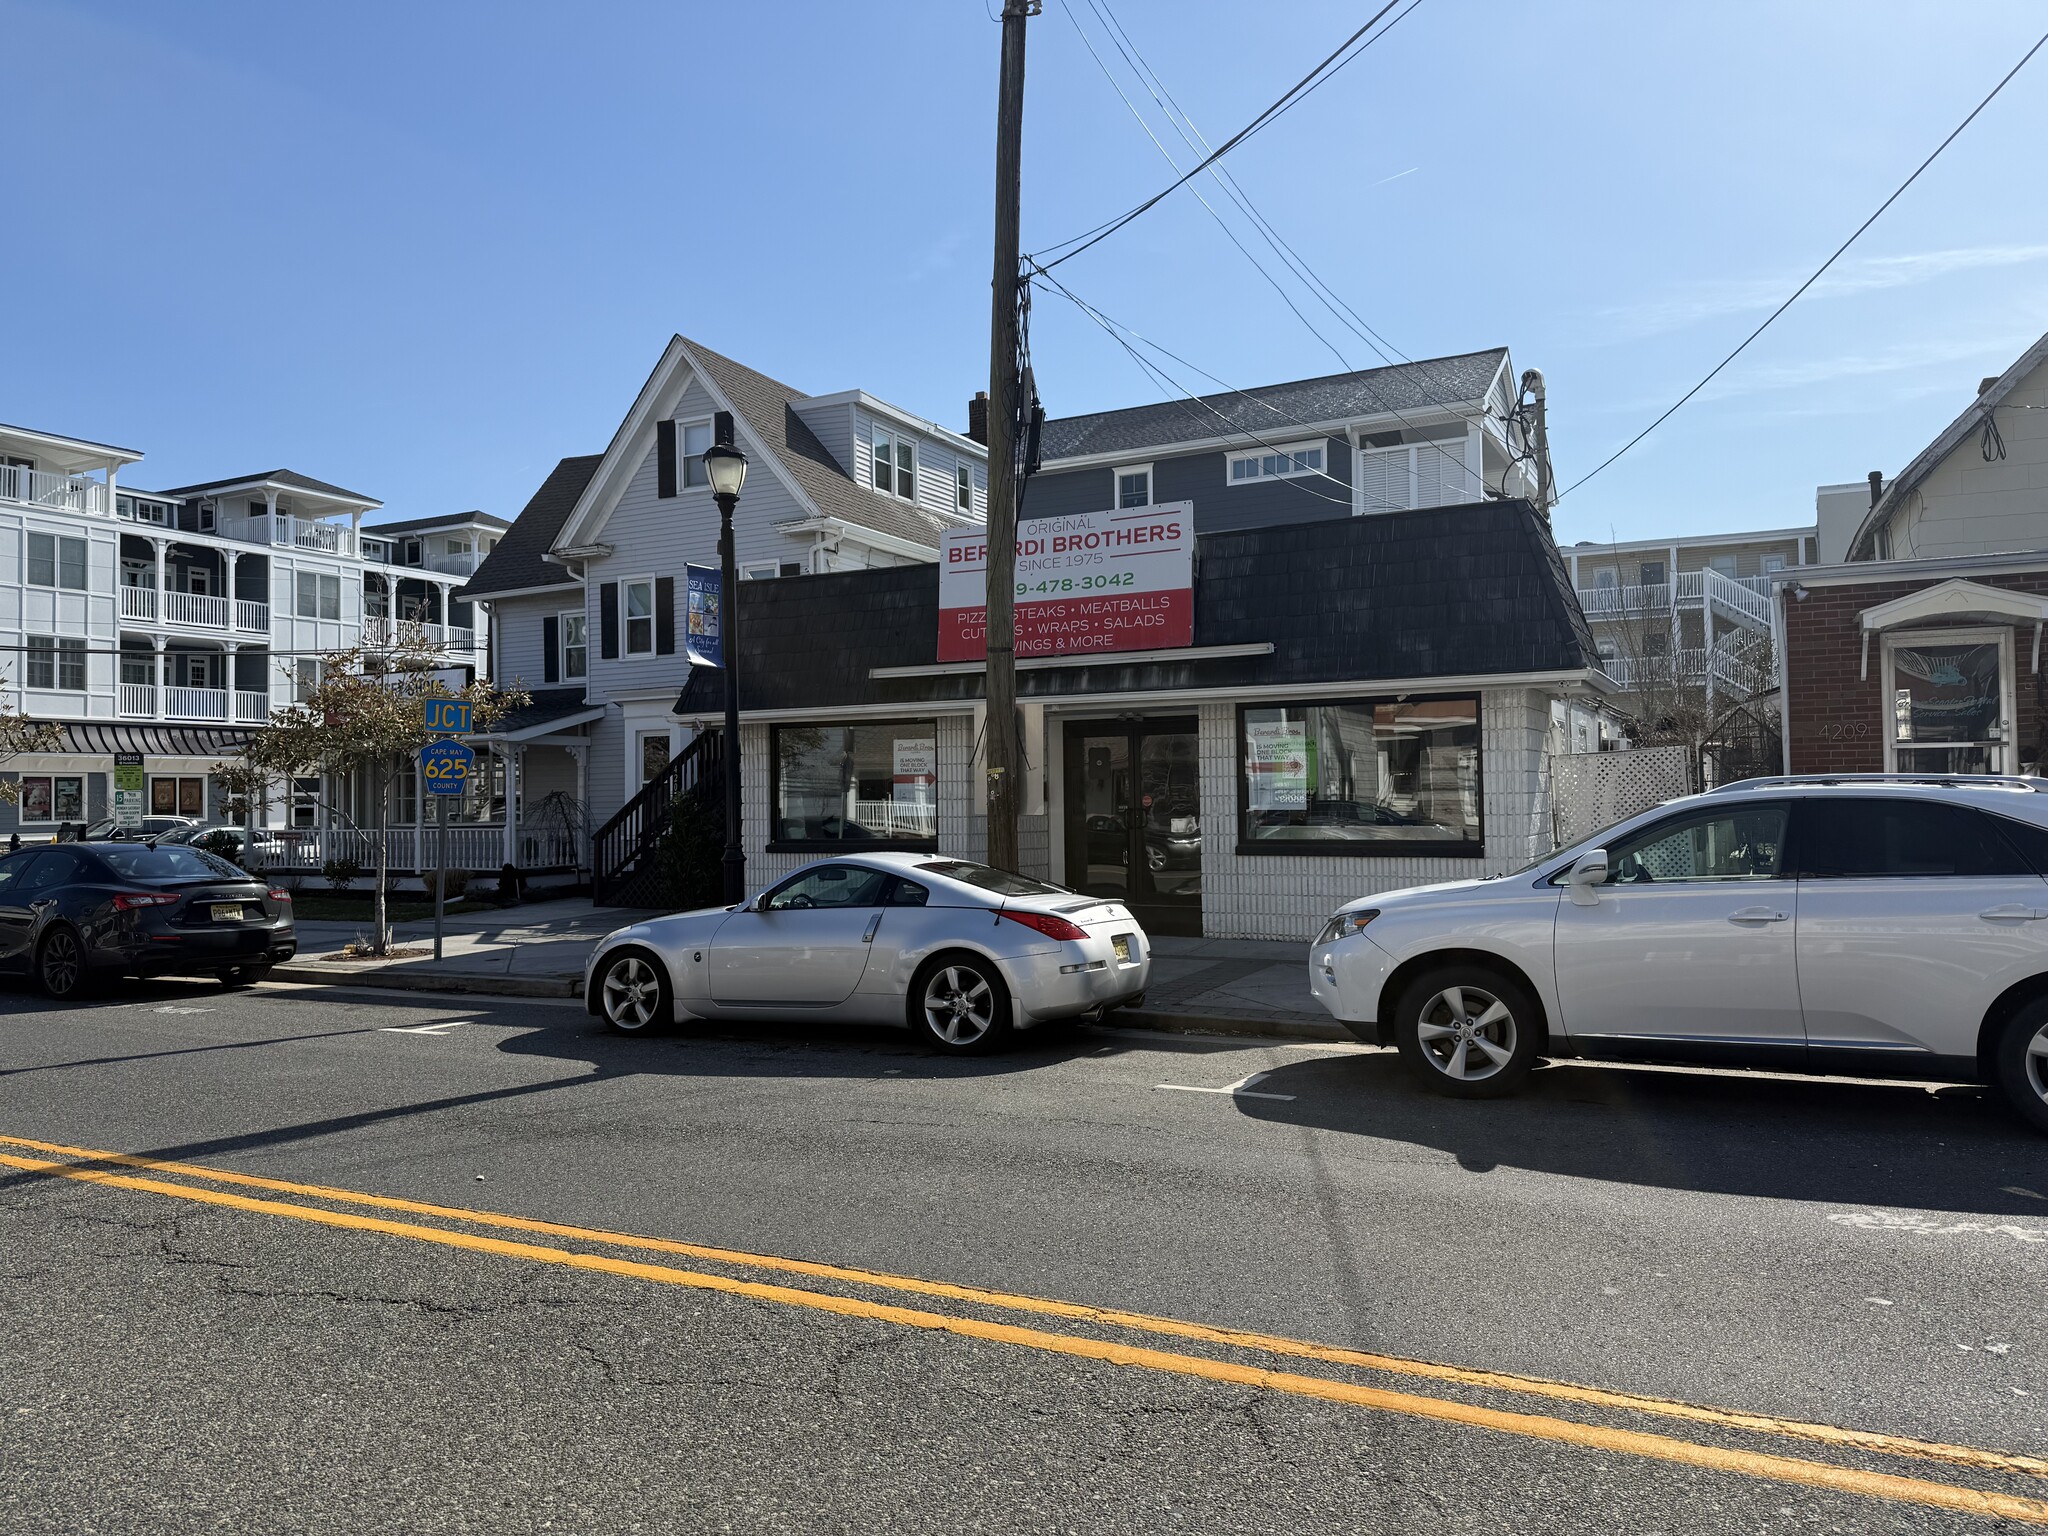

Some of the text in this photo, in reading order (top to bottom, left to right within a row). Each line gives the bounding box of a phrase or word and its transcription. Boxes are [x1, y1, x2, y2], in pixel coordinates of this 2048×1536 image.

[1027, 517, 1096, 536] ORIGINAL
[948, 522, 1182, 564] BERRDI BROTHERS
[1019, 552, 1104, 572] SINCE 1975
[688, 579, 719, 593] SEA ISLE
[1016, 572, 1135, 595] 9-478-3042
[957, 611, 987, 625] PIZZ
[1080, 596, 1171, 614] MEATBALLS
[1037, 620, 1090, 634] WRAPS
[1103, 613, 1166, 630] SALADS
[1055, 637, 1066, 649] &
[1070, 634, 1114, 648] MORE
[428, 704, 470, 728] JCT
[1913, 708, 1948, 719] Service
[1818, 723, 1868, 740] 4209
[425, 758, 468, 779] 625
[116, 794, 123, 802] 15
